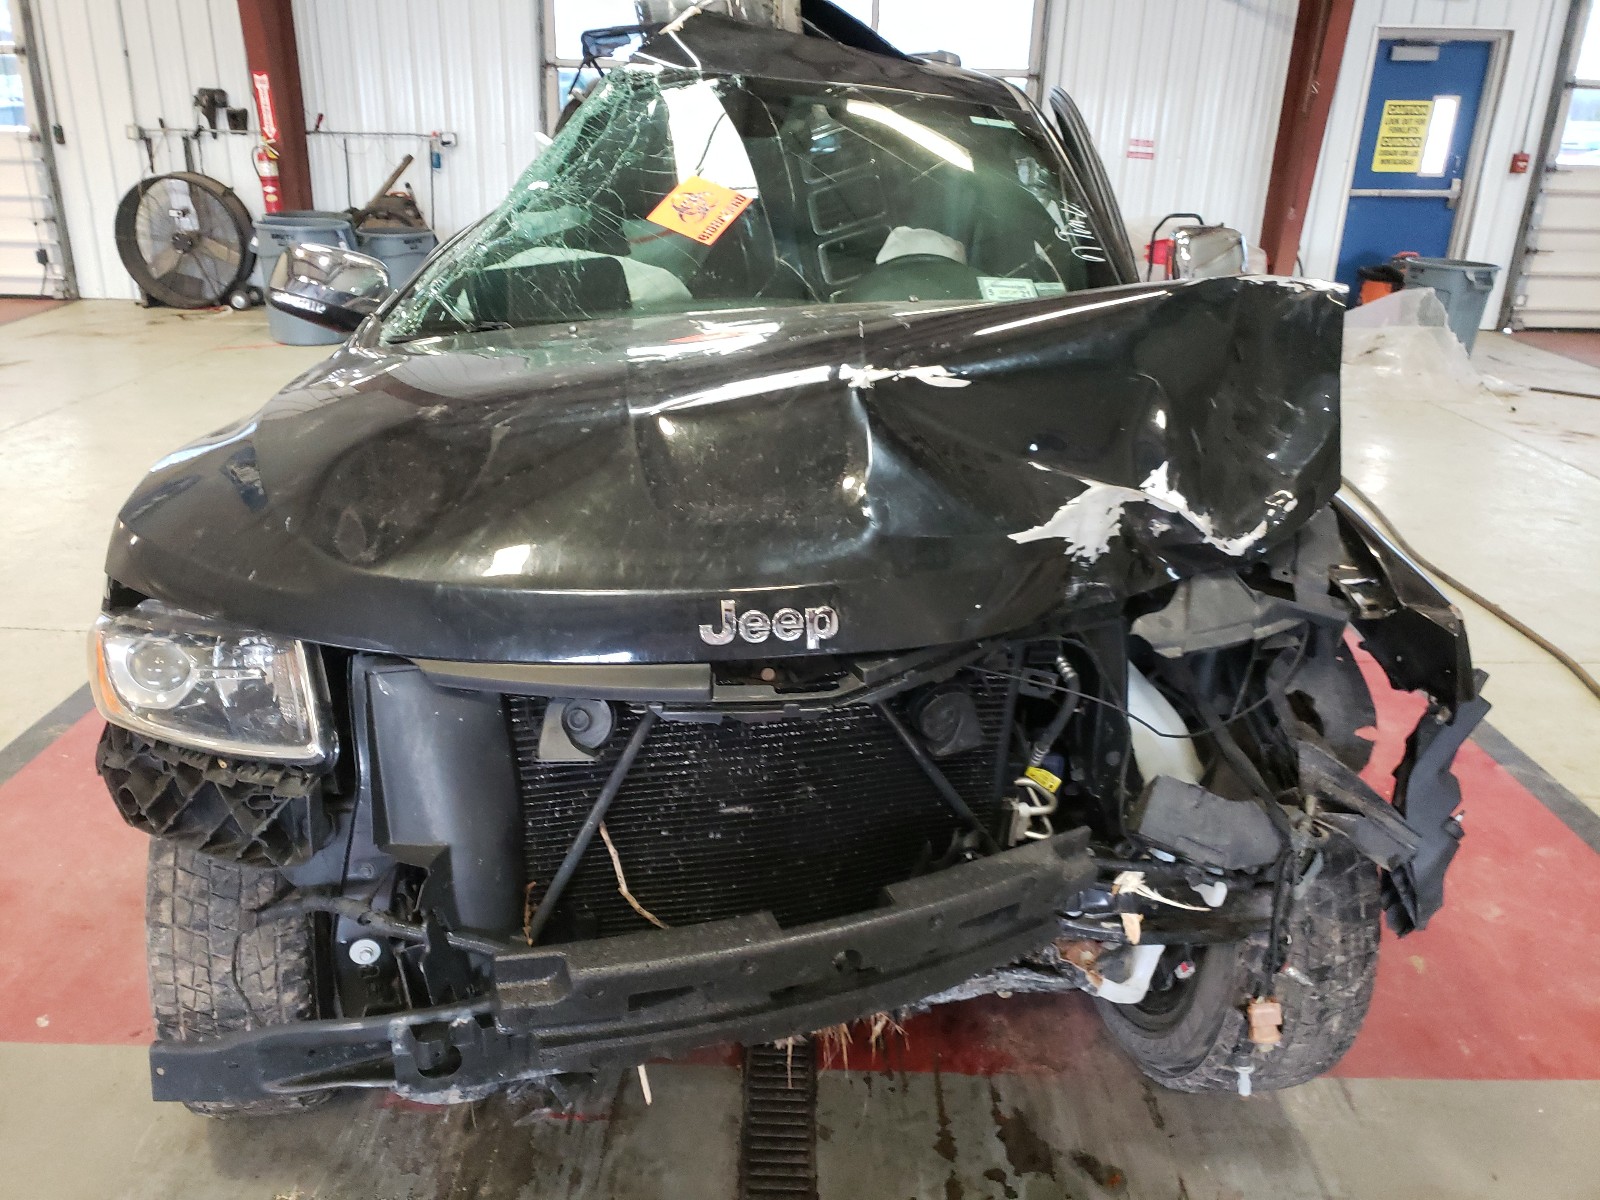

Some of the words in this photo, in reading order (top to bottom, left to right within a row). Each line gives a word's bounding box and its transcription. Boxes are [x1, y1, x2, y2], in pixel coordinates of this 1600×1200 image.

[1388, 105, 1428, 115] CAUTION
[698, 193, 747, 241] BIOHARD
[699, 599, 839, 650] Jeep
